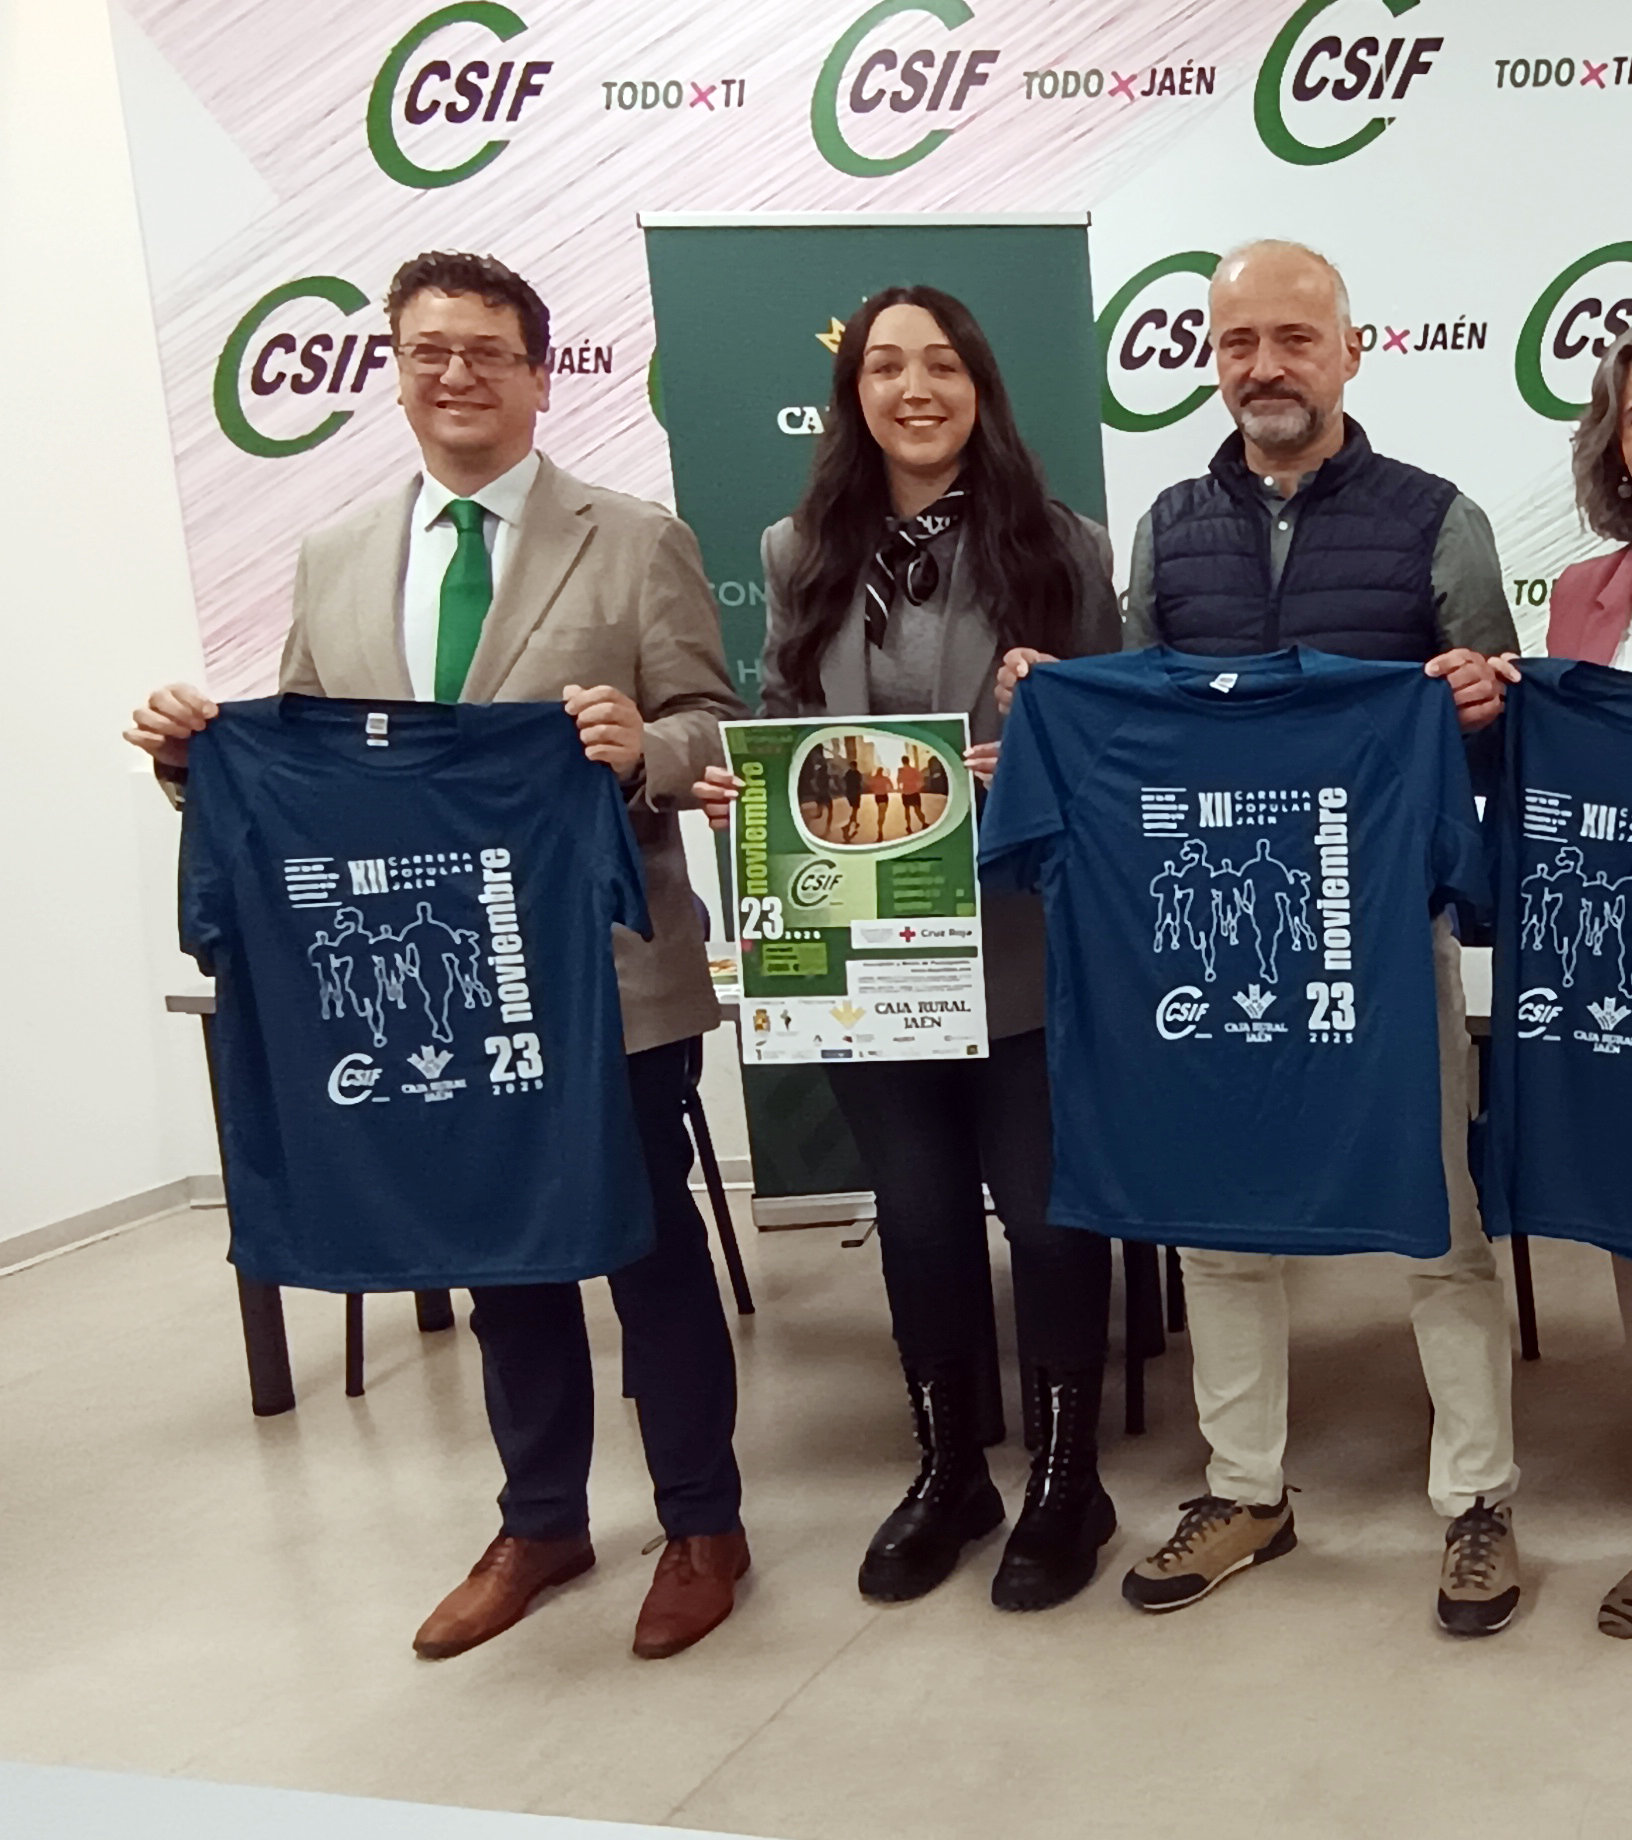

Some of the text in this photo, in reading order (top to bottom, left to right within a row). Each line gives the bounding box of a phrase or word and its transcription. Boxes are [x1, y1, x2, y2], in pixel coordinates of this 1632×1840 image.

[404, 61, 553, 124] CSIF
[849, 49, 1000, 114] CSIF
[1292, 36, 1443, 101] CSIF
[251, 333, 392, 396] CSIF
[1120, 309, 1213, 370] CSI
[741, 762, 767, 895] noviembre
[800, 874, 843, 891] CSIF
[1314, 788, 1352, 970] noviembre
[479, 848, 533, 1023] noviembre
[740, 896, 783, 940] 23
[1306, 982, 1356, 1031] 23
[485, 1033, 544, 1083] 23
